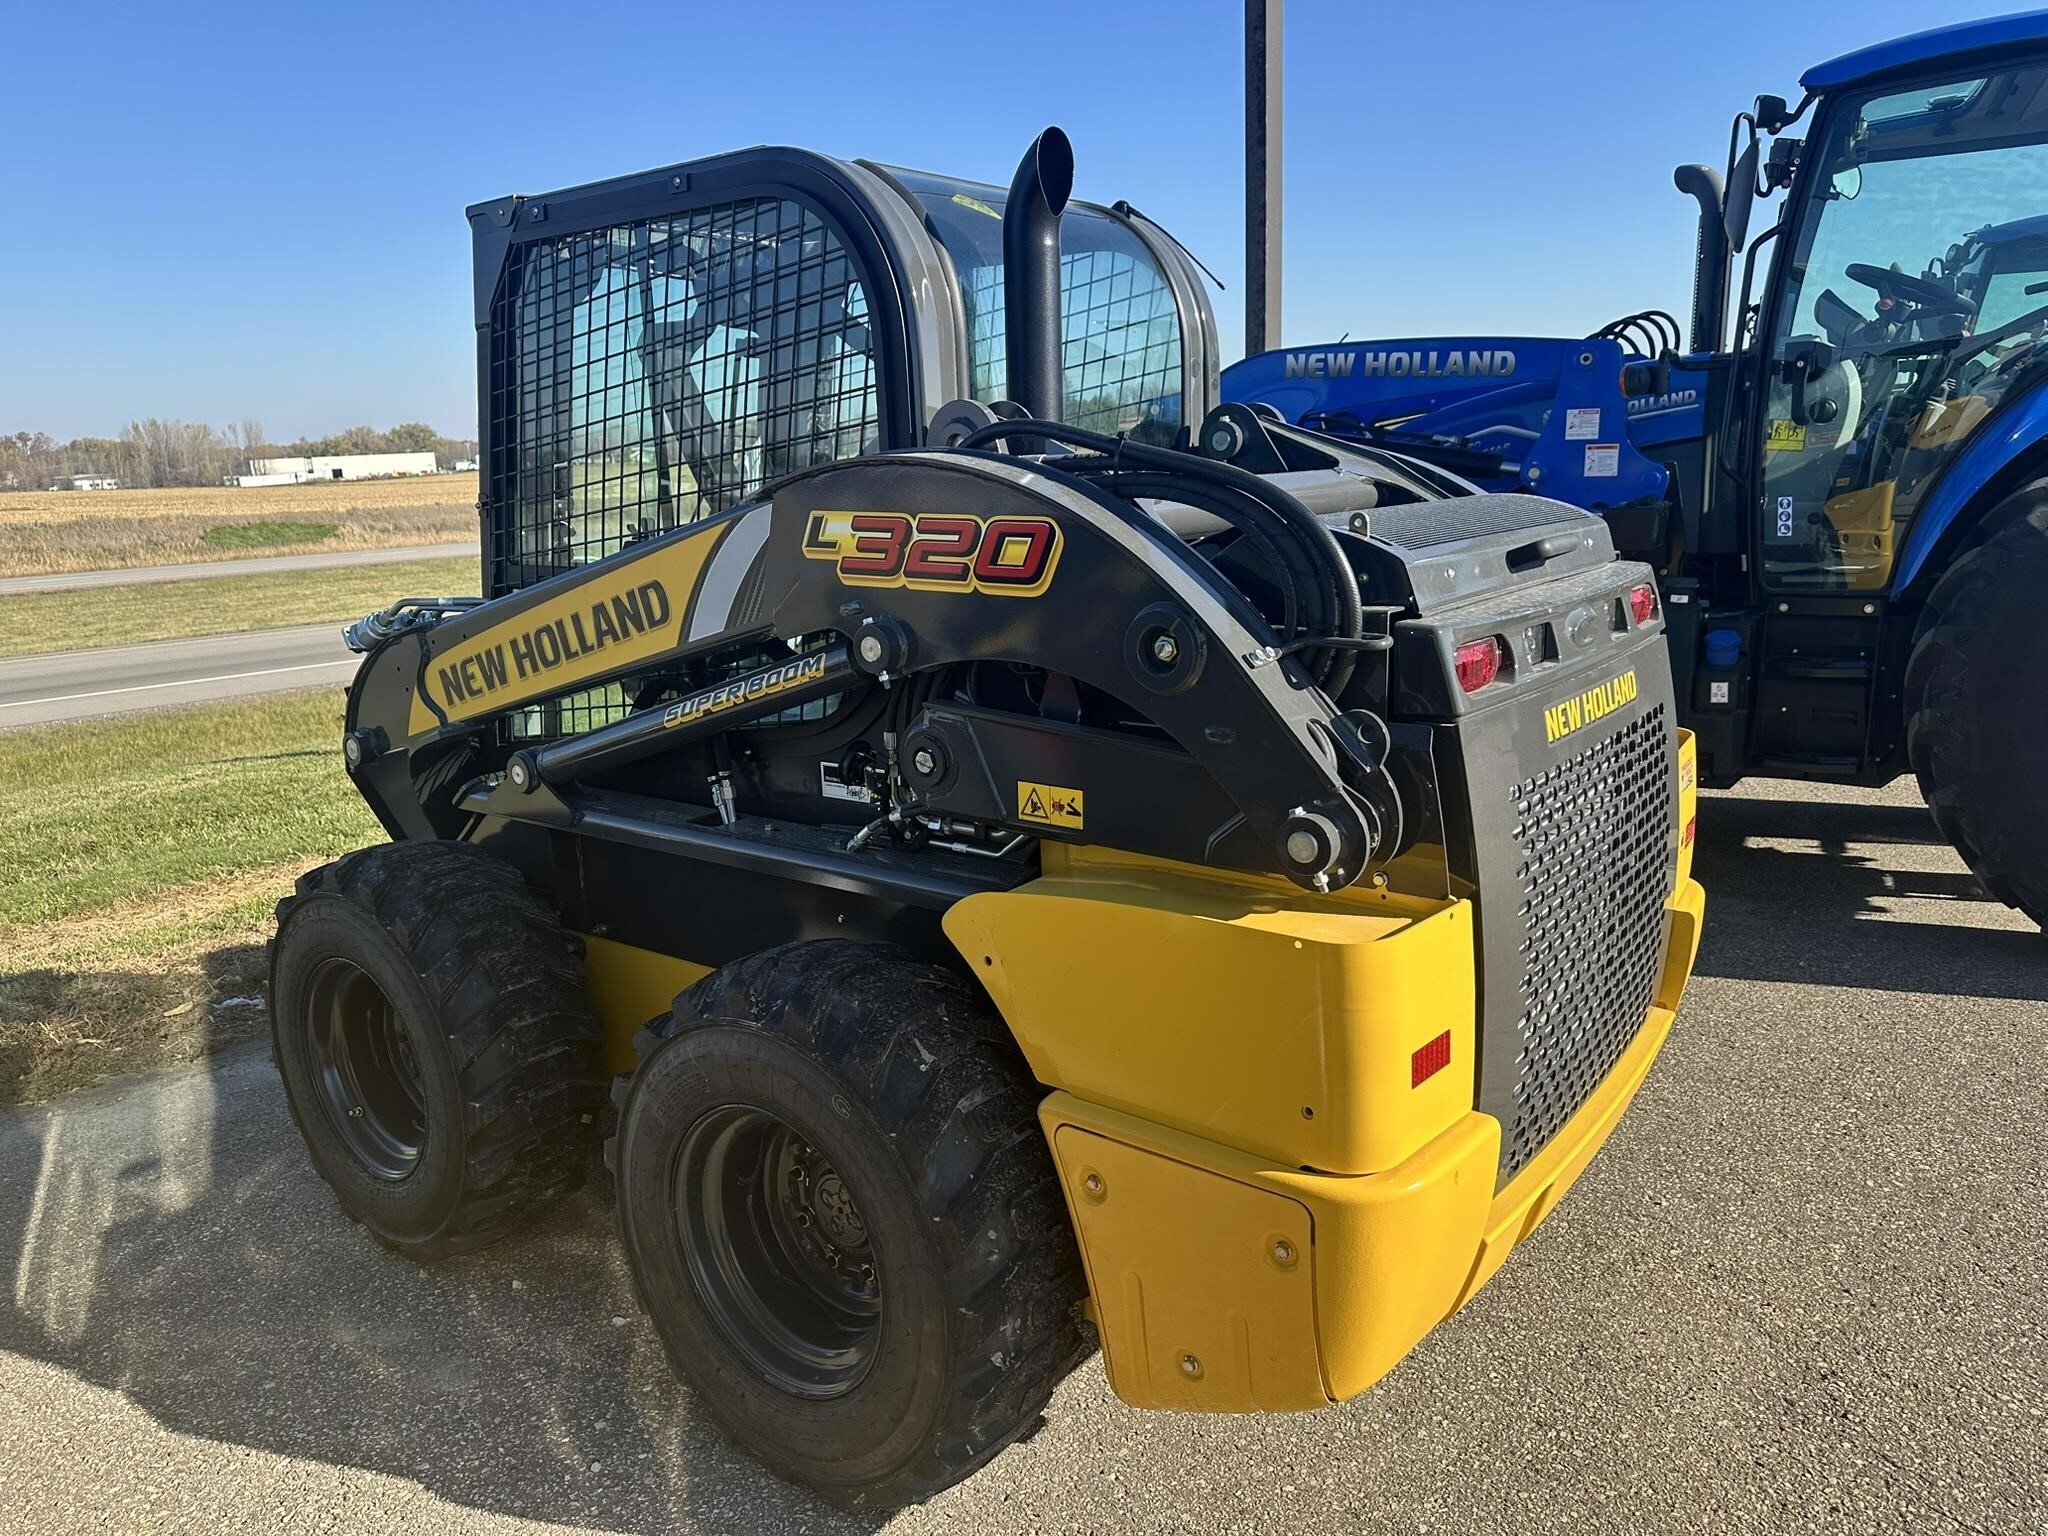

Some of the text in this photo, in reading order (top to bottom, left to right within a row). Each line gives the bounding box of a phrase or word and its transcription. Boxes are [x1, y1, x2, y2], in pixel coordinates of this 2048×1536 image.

[1285, 350, 1516, 379] NEW HOLLAND
[1627, 389, 1697, 413] OLLAND
[802, 511, 1064, 597] L320
[438, 579, 672, 707] NEW HOLLAND
[664, 653, 826, 728] SUPER BOOM
[1545, 670, 1638, 743] NEW HOLLAND
